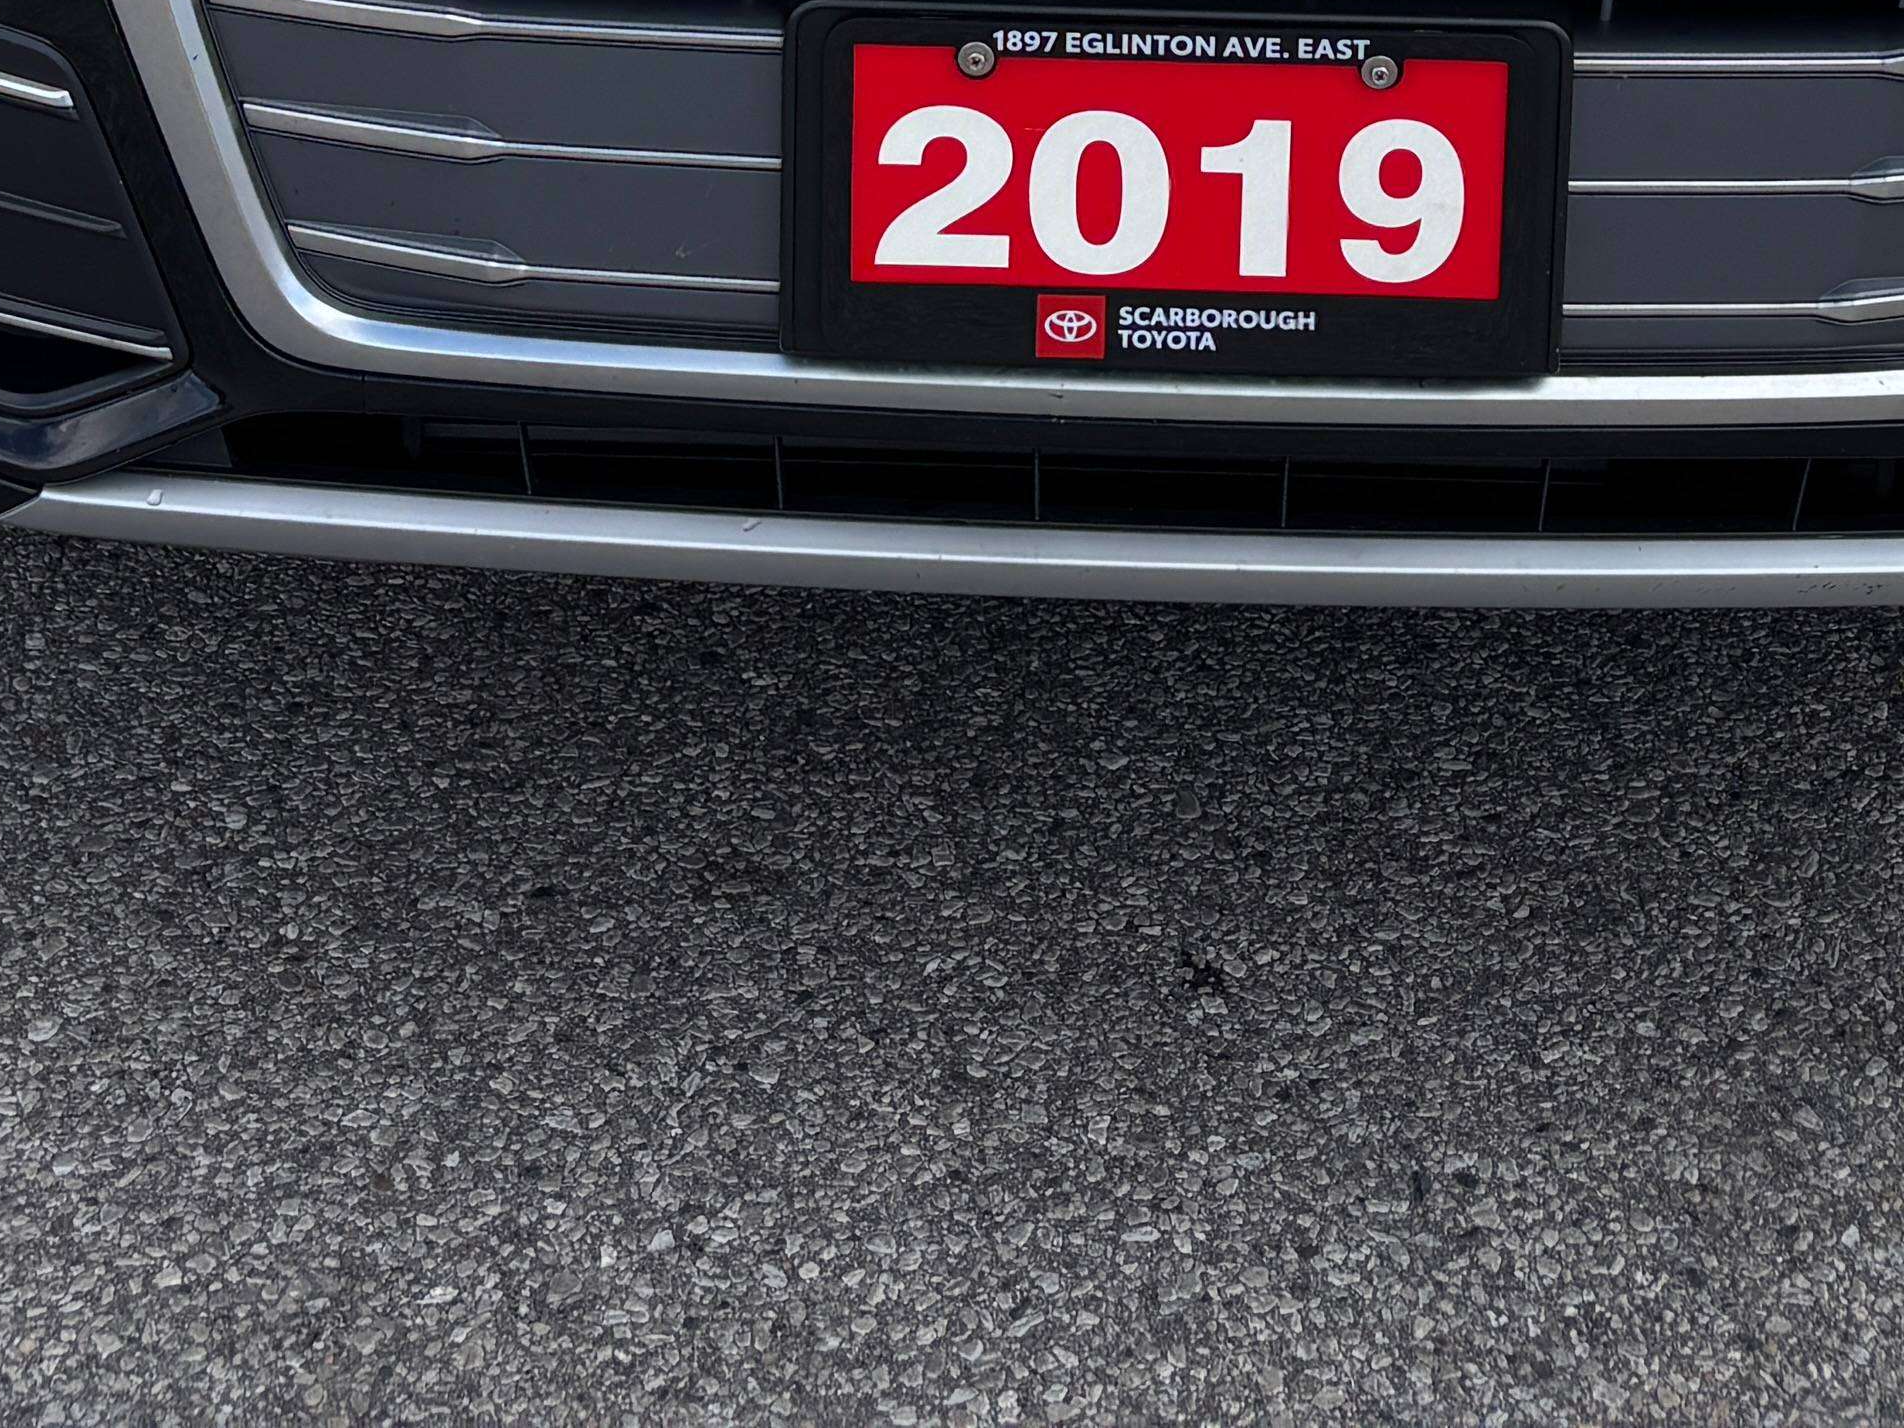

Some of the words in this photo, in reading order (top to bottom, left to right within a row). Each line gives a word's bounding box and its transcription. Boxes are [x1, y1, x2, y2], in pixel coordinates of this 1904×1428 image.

[993, 30, 1058, 54] 1897
[1065, 31, 1216, 59] EGLINTON
[1224, 36, 1289, 60] AVE.
[1295, 38, 1370, 61] EAST
[874, 104, 1466, 284] 2019
[1118, 306, 1316, 333] SCARBOROUGH
[1118, 329, 1216, 352] TOYOTA
